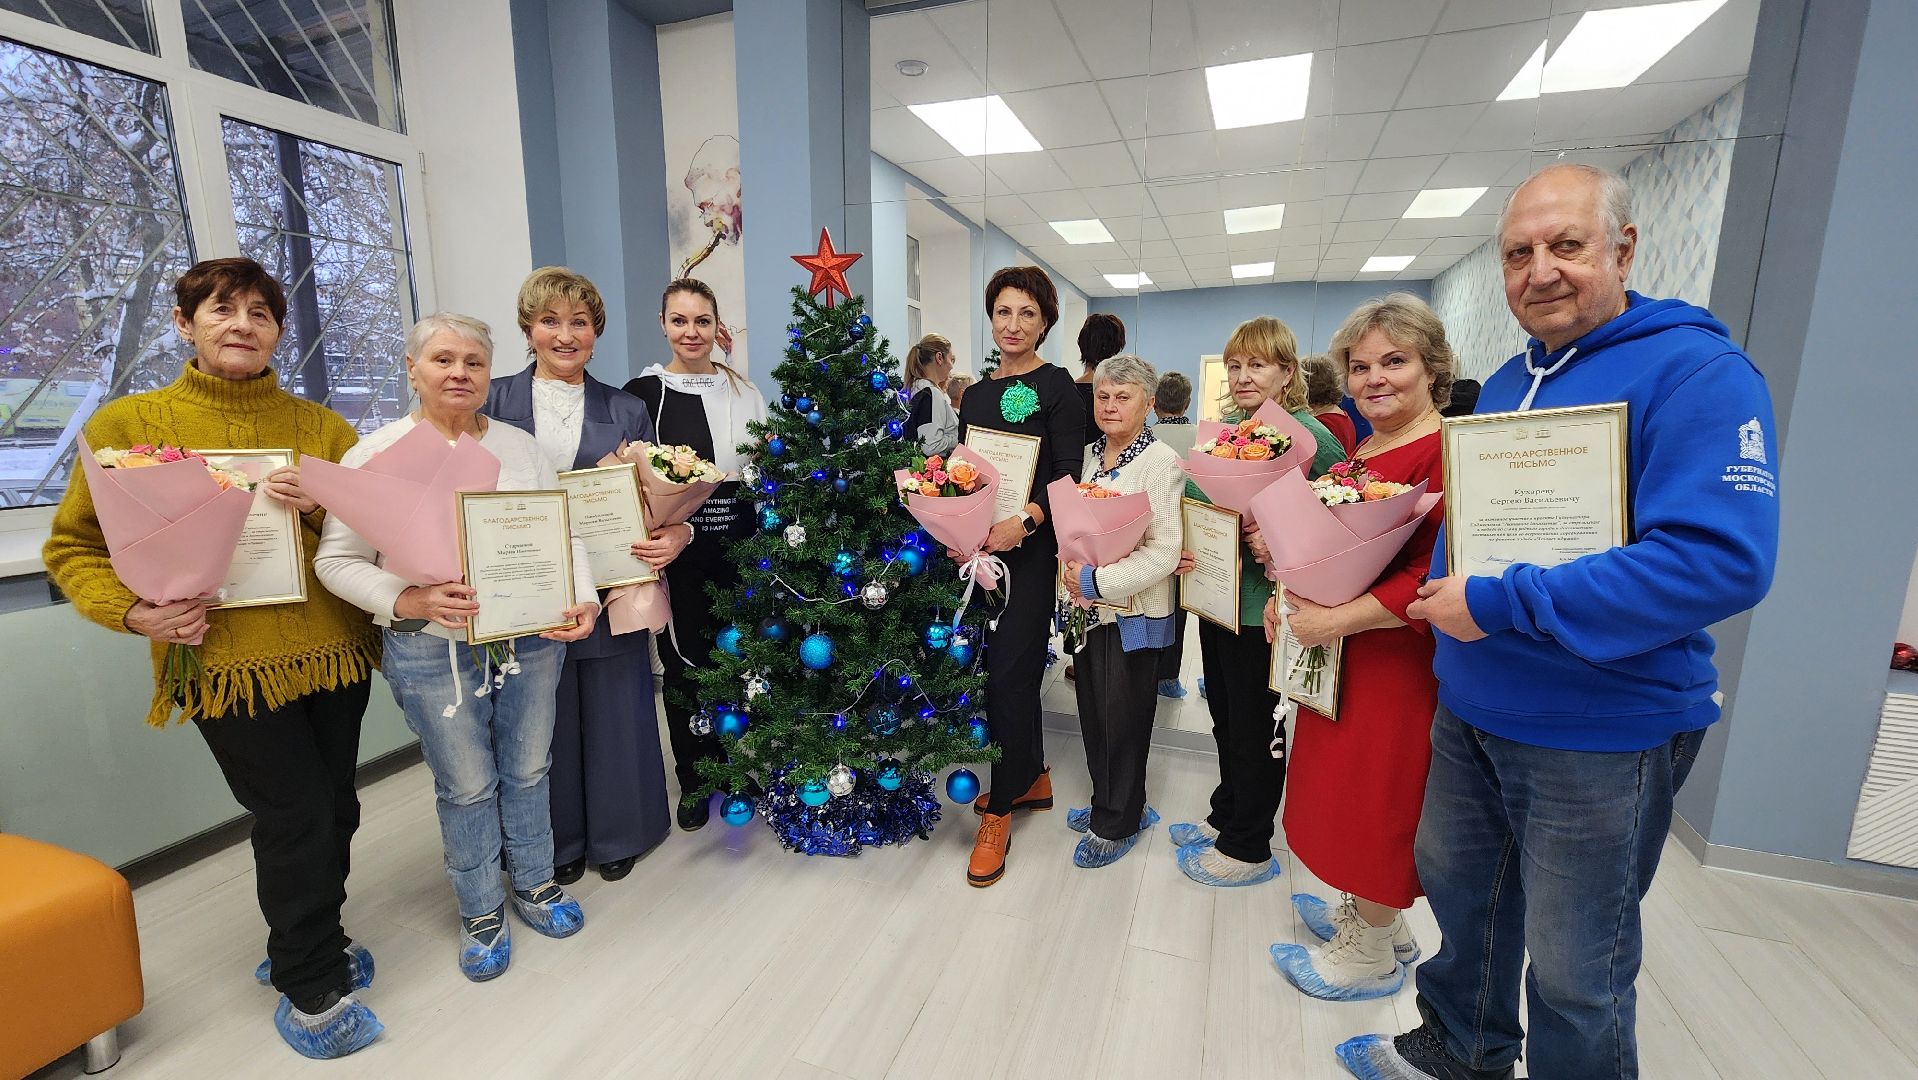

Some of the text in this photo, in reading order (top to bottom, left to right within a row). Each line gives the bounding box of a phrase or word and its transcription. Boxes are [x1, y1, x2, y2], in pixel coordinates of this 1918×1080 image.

[1479, 446, 1588, 461] БЛАГОДАРСТВЕННОЕ
[1509, 459, 1556, 469] ПИСЬМО
[1490, 497, 1522, 506] Сергею
[702, 506, 730, 514] AMAZING
